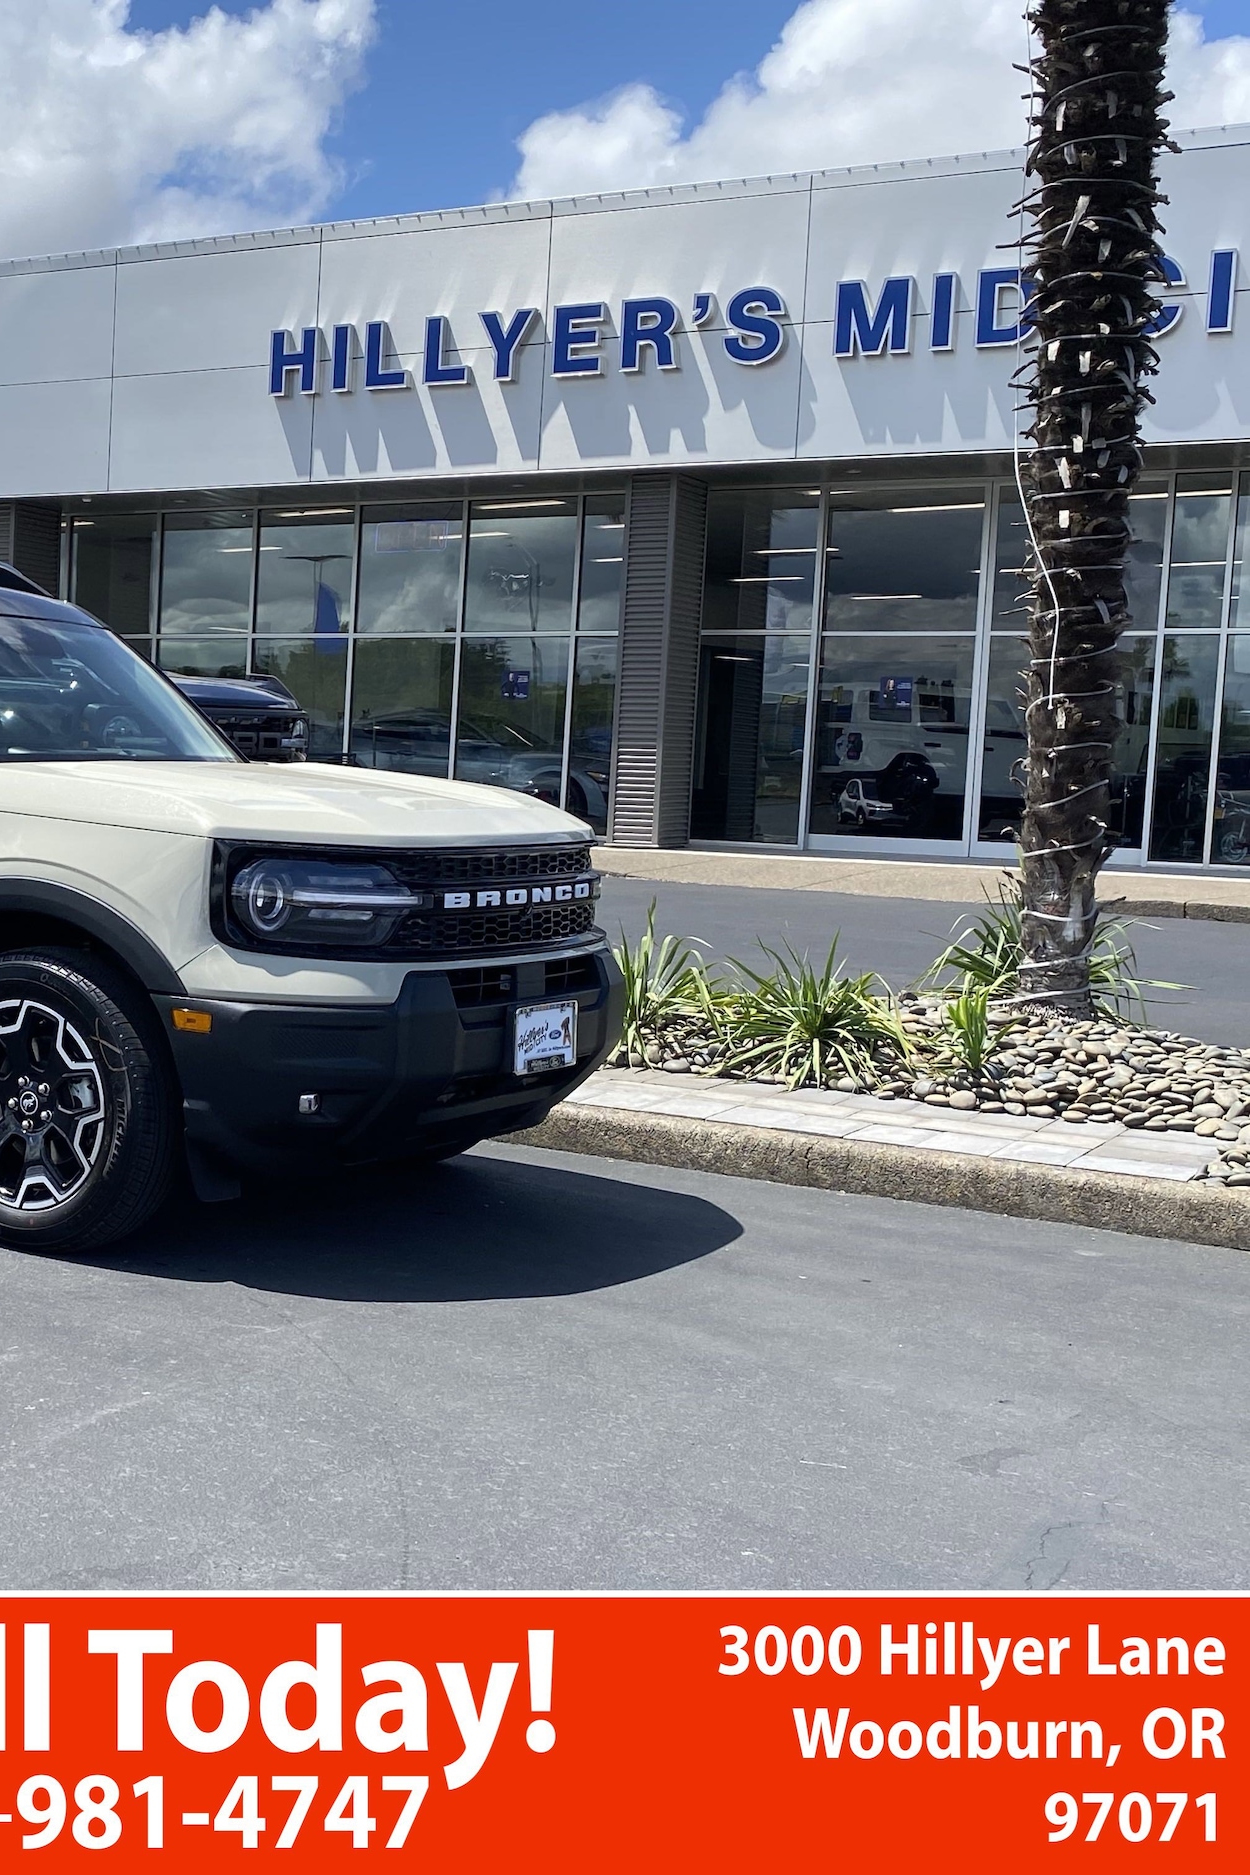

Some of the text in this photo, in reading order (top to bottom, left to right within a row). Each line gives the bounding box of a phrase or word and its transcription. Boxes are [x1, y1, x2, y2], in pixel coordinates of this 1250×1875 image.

[269, 286, 786, 396] HILLYER'S
[833, 266, 1040, 357] MID
[444, 883, 590, 909] BRONCO
